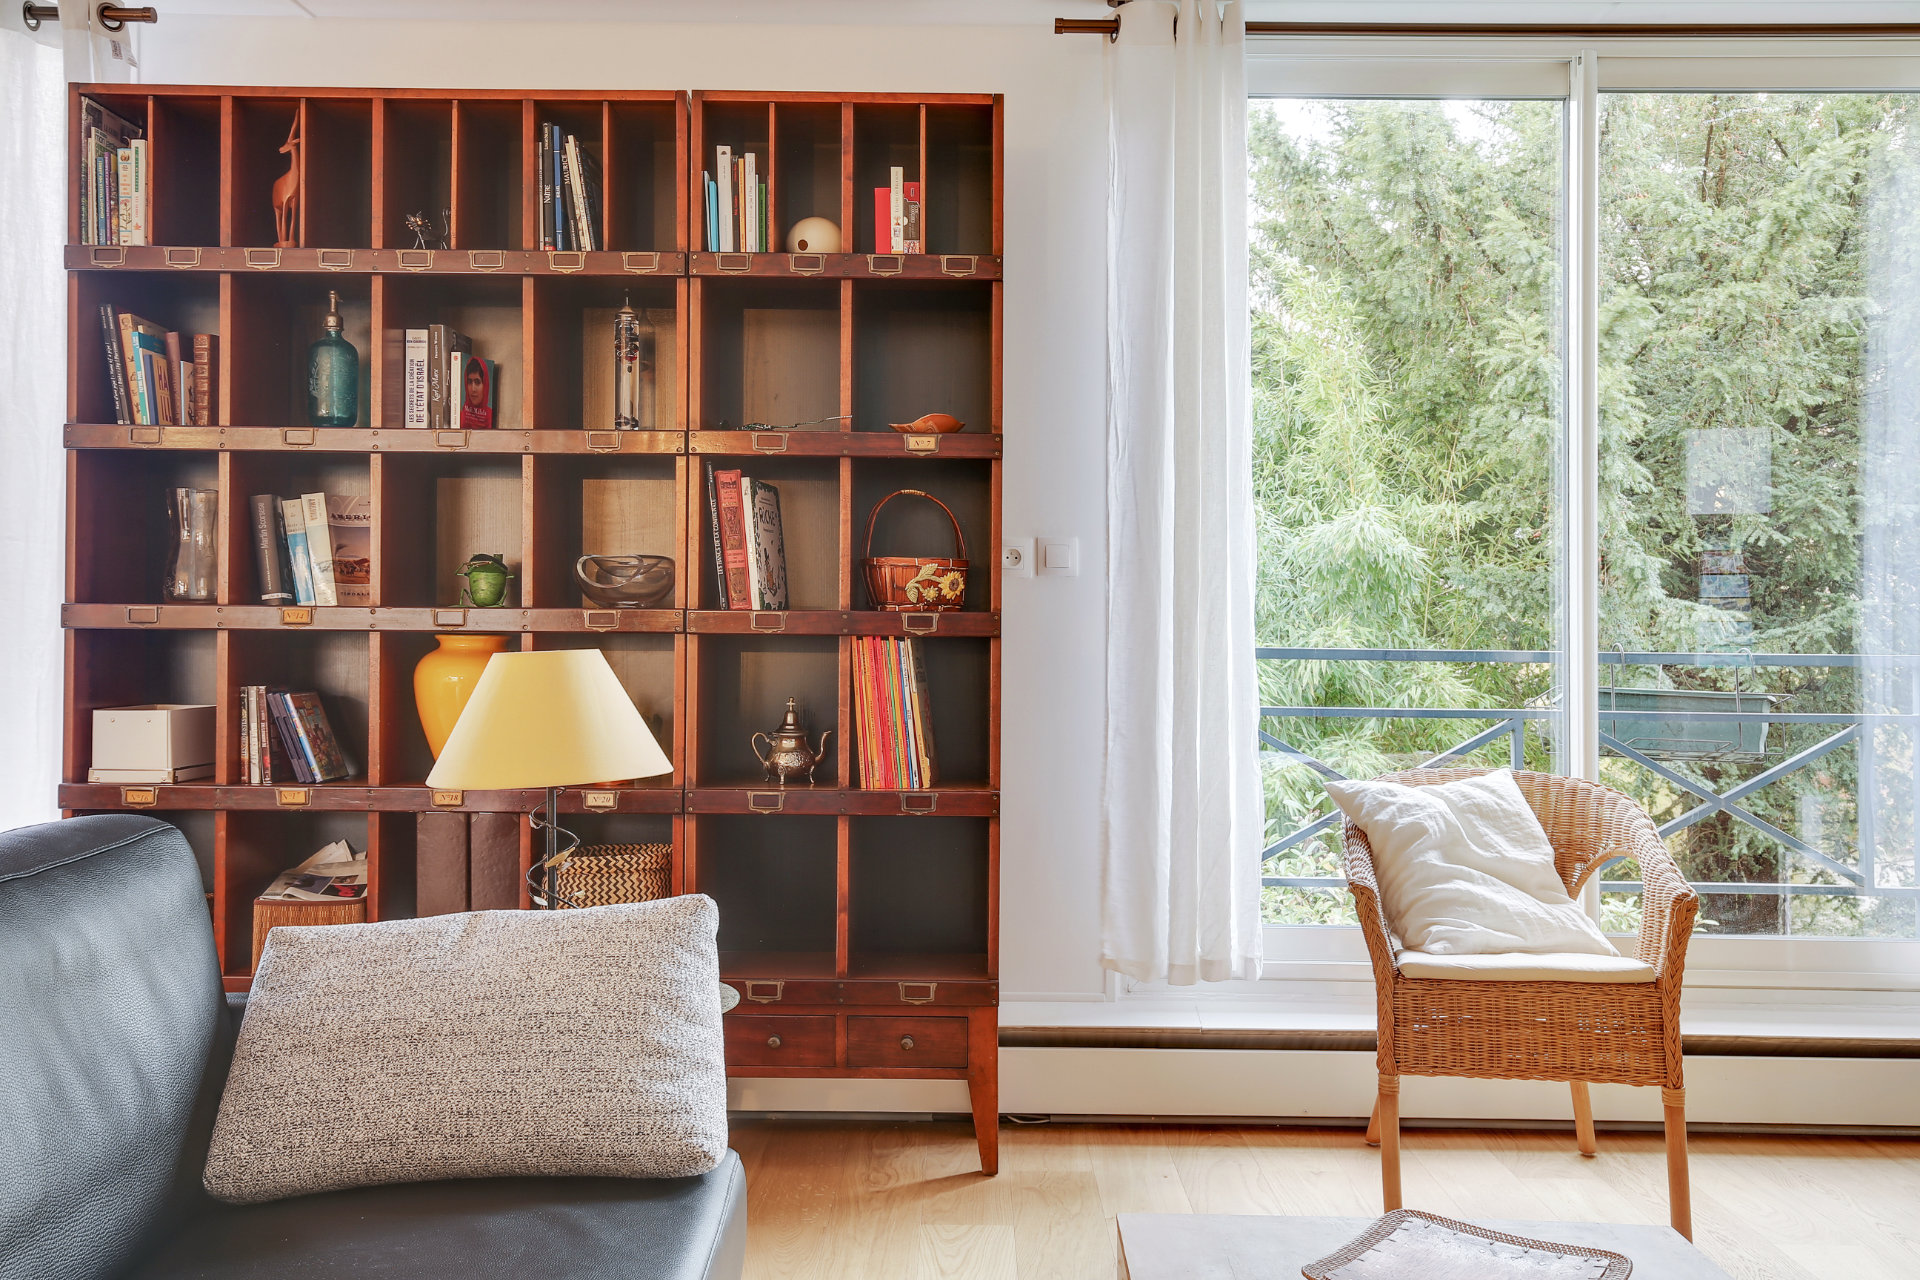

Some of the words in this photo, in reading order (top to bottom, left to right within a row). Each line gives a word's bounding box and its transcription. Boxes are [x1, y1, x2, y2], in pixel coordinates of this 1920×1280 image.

[561, 155, 570, 185] MAURICE
[414, 359, 424, 389] D'ISRAËL
[414, 391, 424, 412] L'ÉTAT
[432, 390, 440, 402] Karl
[416, 414, 424, 423] DE
[258, 502, 267, 530] Scorsese
[260, 528, 269, 549] Martin
